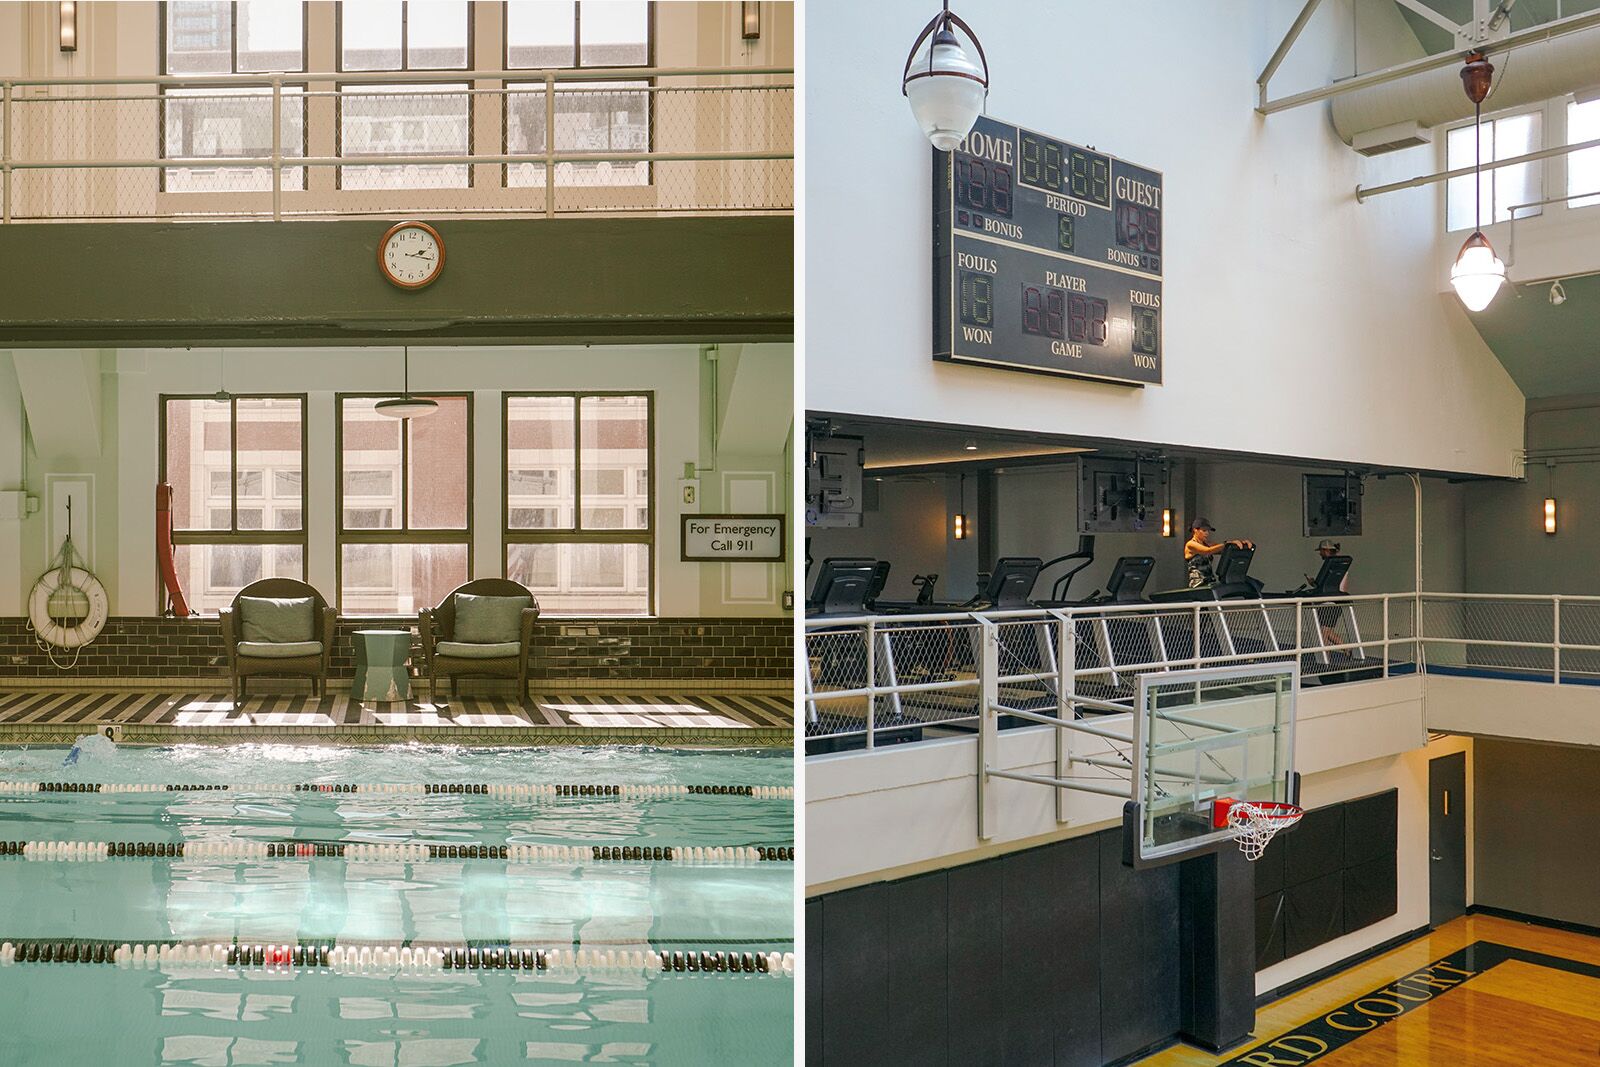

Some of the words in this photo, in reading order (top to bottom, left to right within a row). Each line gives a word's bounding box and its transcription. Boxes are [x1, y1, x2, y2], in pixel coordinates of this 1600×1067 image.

[1116, 176, 1160, 209] GUEST
[1046, 194, 1086, 217] PERIOD
[985, 218, 1023, 239] BONUS
[958, 252, 997, 274] FOULS
[1108, 248, 1139, 267] BONUS
[419, 270, 424, 278] 5
[1046, 271, 1087, 293] PLAYER
[1130, 290, 1160, 307] FOULS
[963, 327, 992, 344] WON
[1051, 341, 1082, 358] GAME
[1133, 354, 1156, 370] WON
[690, 523, 710, 534] For
[714, 523, 776, 537] Emergency
[711, 540, 732, 551] Call
[737, 540, 753, 551] 911
[1325, 960, 1477, 1031] COURT
